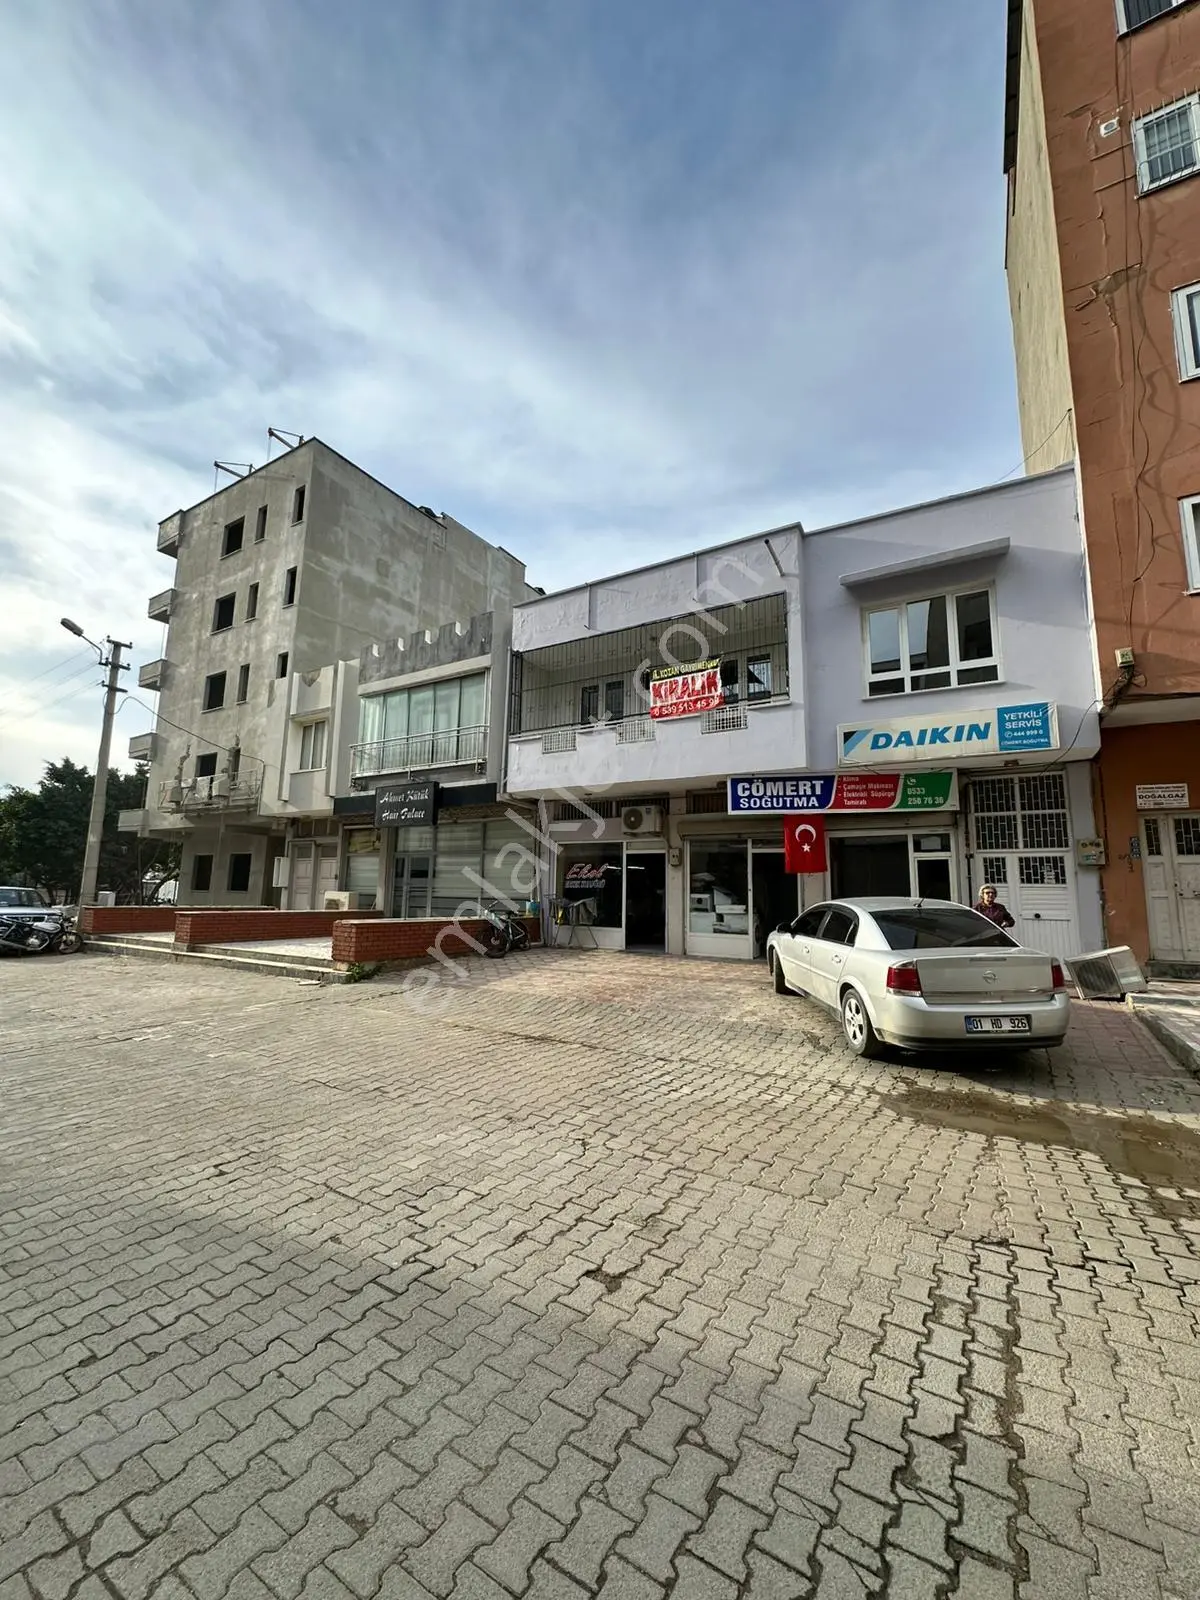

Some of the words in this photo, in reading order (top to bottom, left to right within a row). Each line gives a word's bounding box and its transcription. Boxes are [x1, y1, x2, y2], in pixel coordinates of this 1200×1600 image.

[1004, 709, 1042, 720] YETKİLİ
[1005, 719, 1042, 729] SERVİS
[870, 722, 992, 750] DAIKIN
[737, 779, 824, 797] CÖMERT
[740, 795, 819, 808] SOĞUTMA
[972, 1019, 983, 1029] 01
[990, 1018, 1003, 1029] HD
[1009, 1018, 1027, 1028] 926
